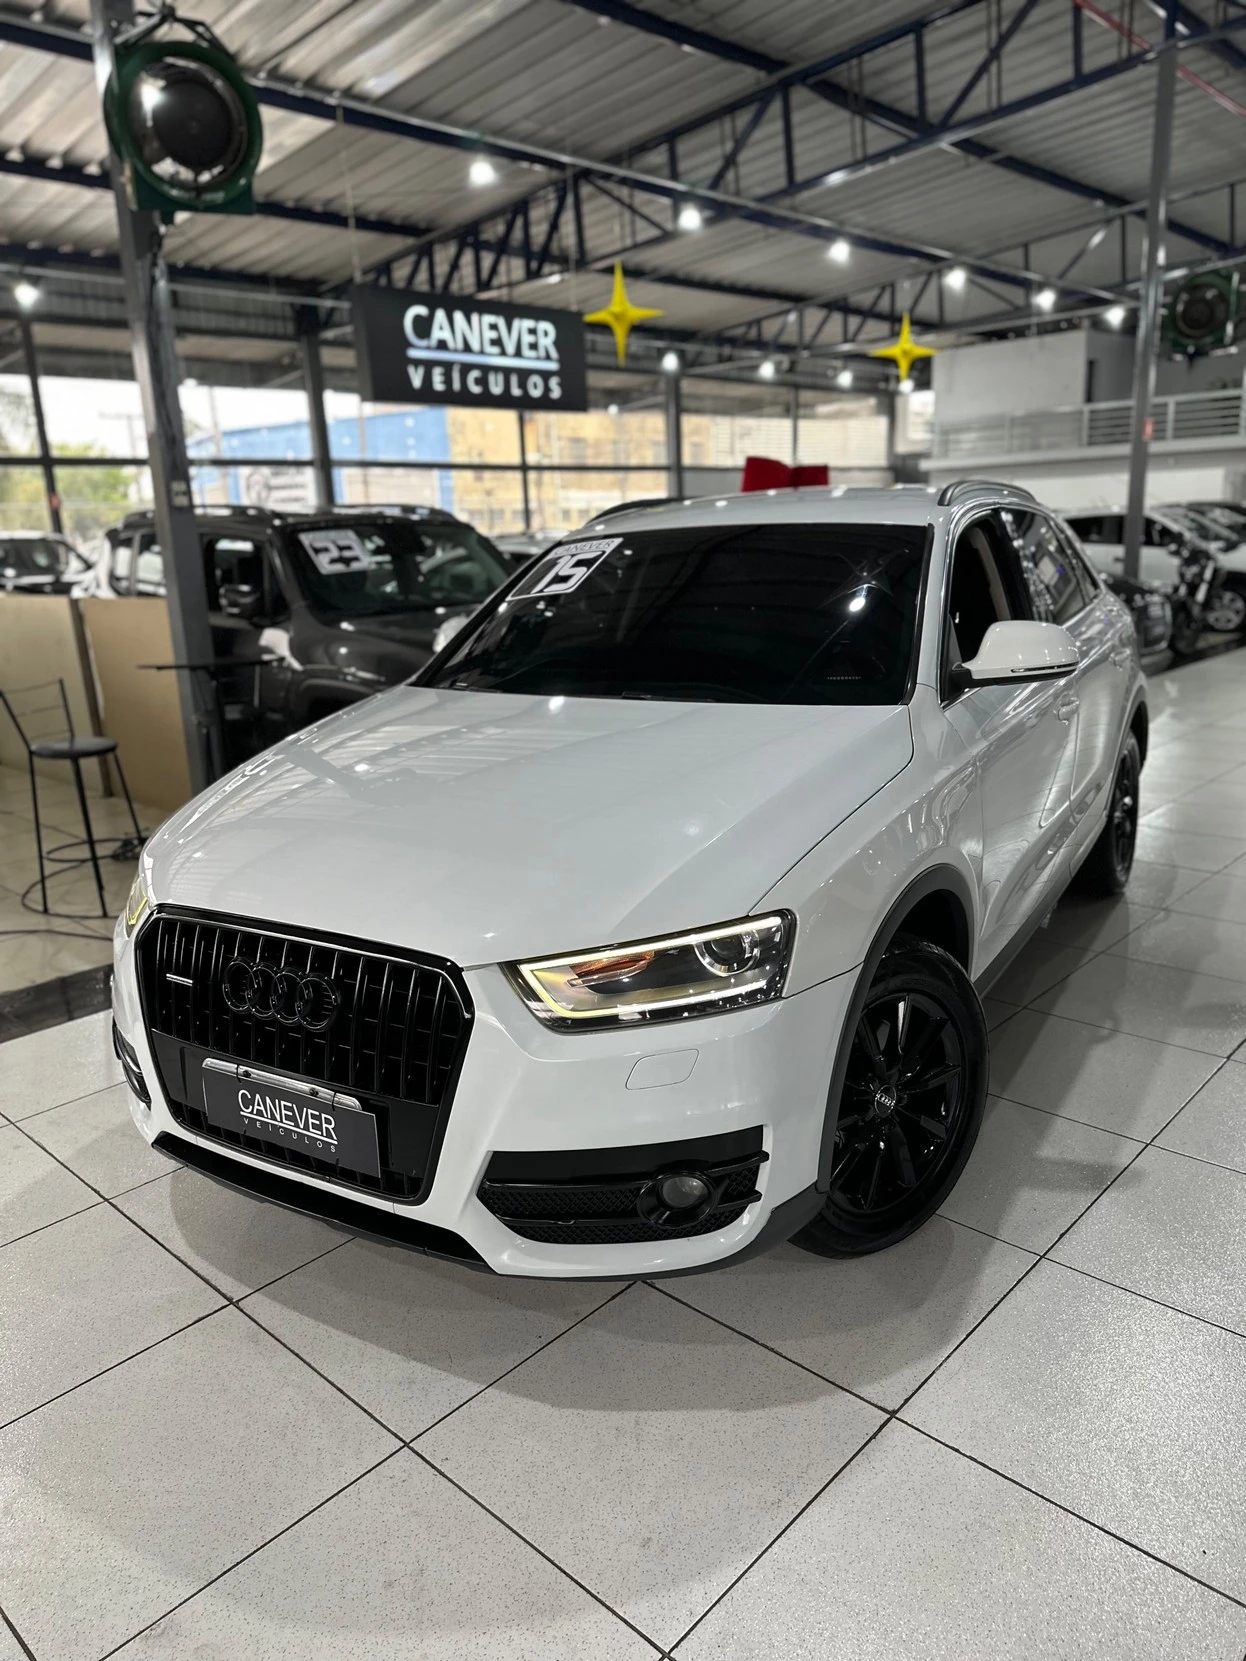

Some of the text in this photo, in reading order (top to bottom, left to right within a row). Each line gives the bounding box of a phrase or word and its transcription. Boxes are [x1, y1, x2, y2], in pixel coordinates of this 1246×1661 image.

[403, 304, 559, 361] CANEVER
[407, 363, 562, 399] VEÍCULOS
[238, 1089, 338, 1141] CANEVER
